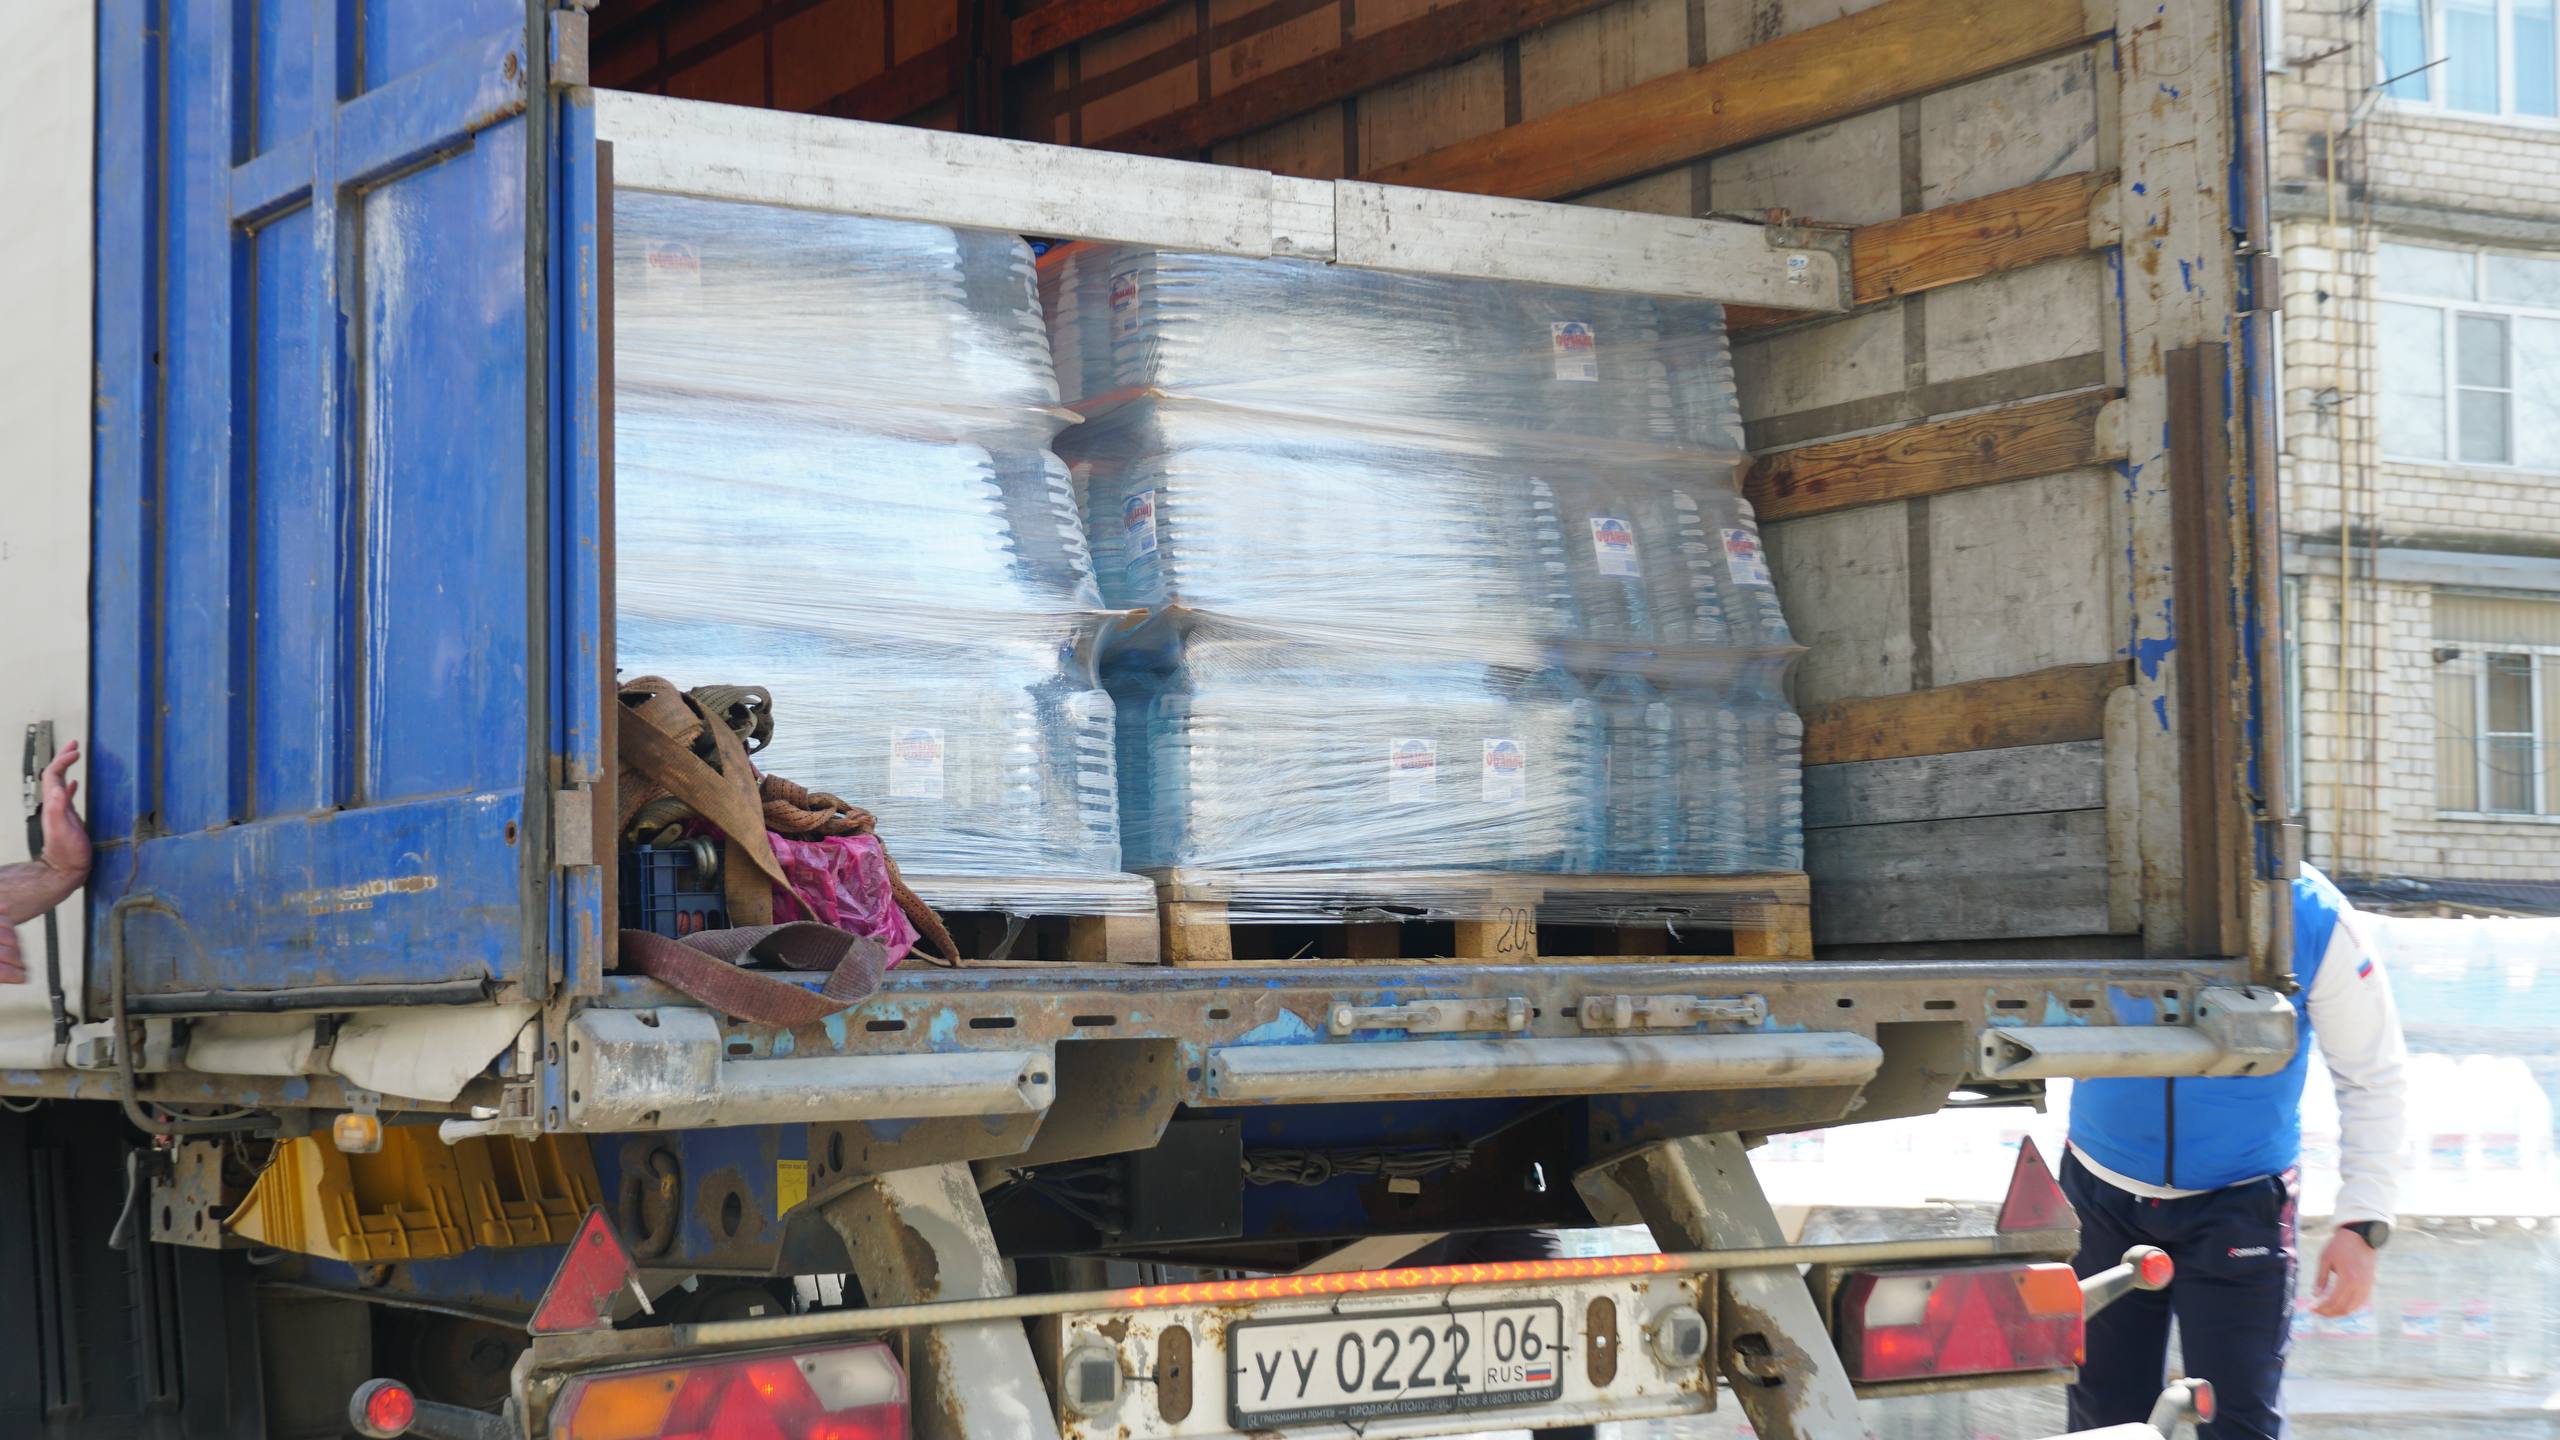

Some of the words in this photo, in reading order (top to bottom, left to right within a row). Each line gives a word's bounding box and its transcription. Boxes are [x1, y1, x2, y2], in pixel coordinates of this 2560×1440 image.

[1336, 1324, 1471, 1393] 0222
[1494, 1315, 1542, 1362] 06
[1487, 1365, 1524, 1384] RUS
[1349, 1402, 1400, 1417] ПРОДАЖА
